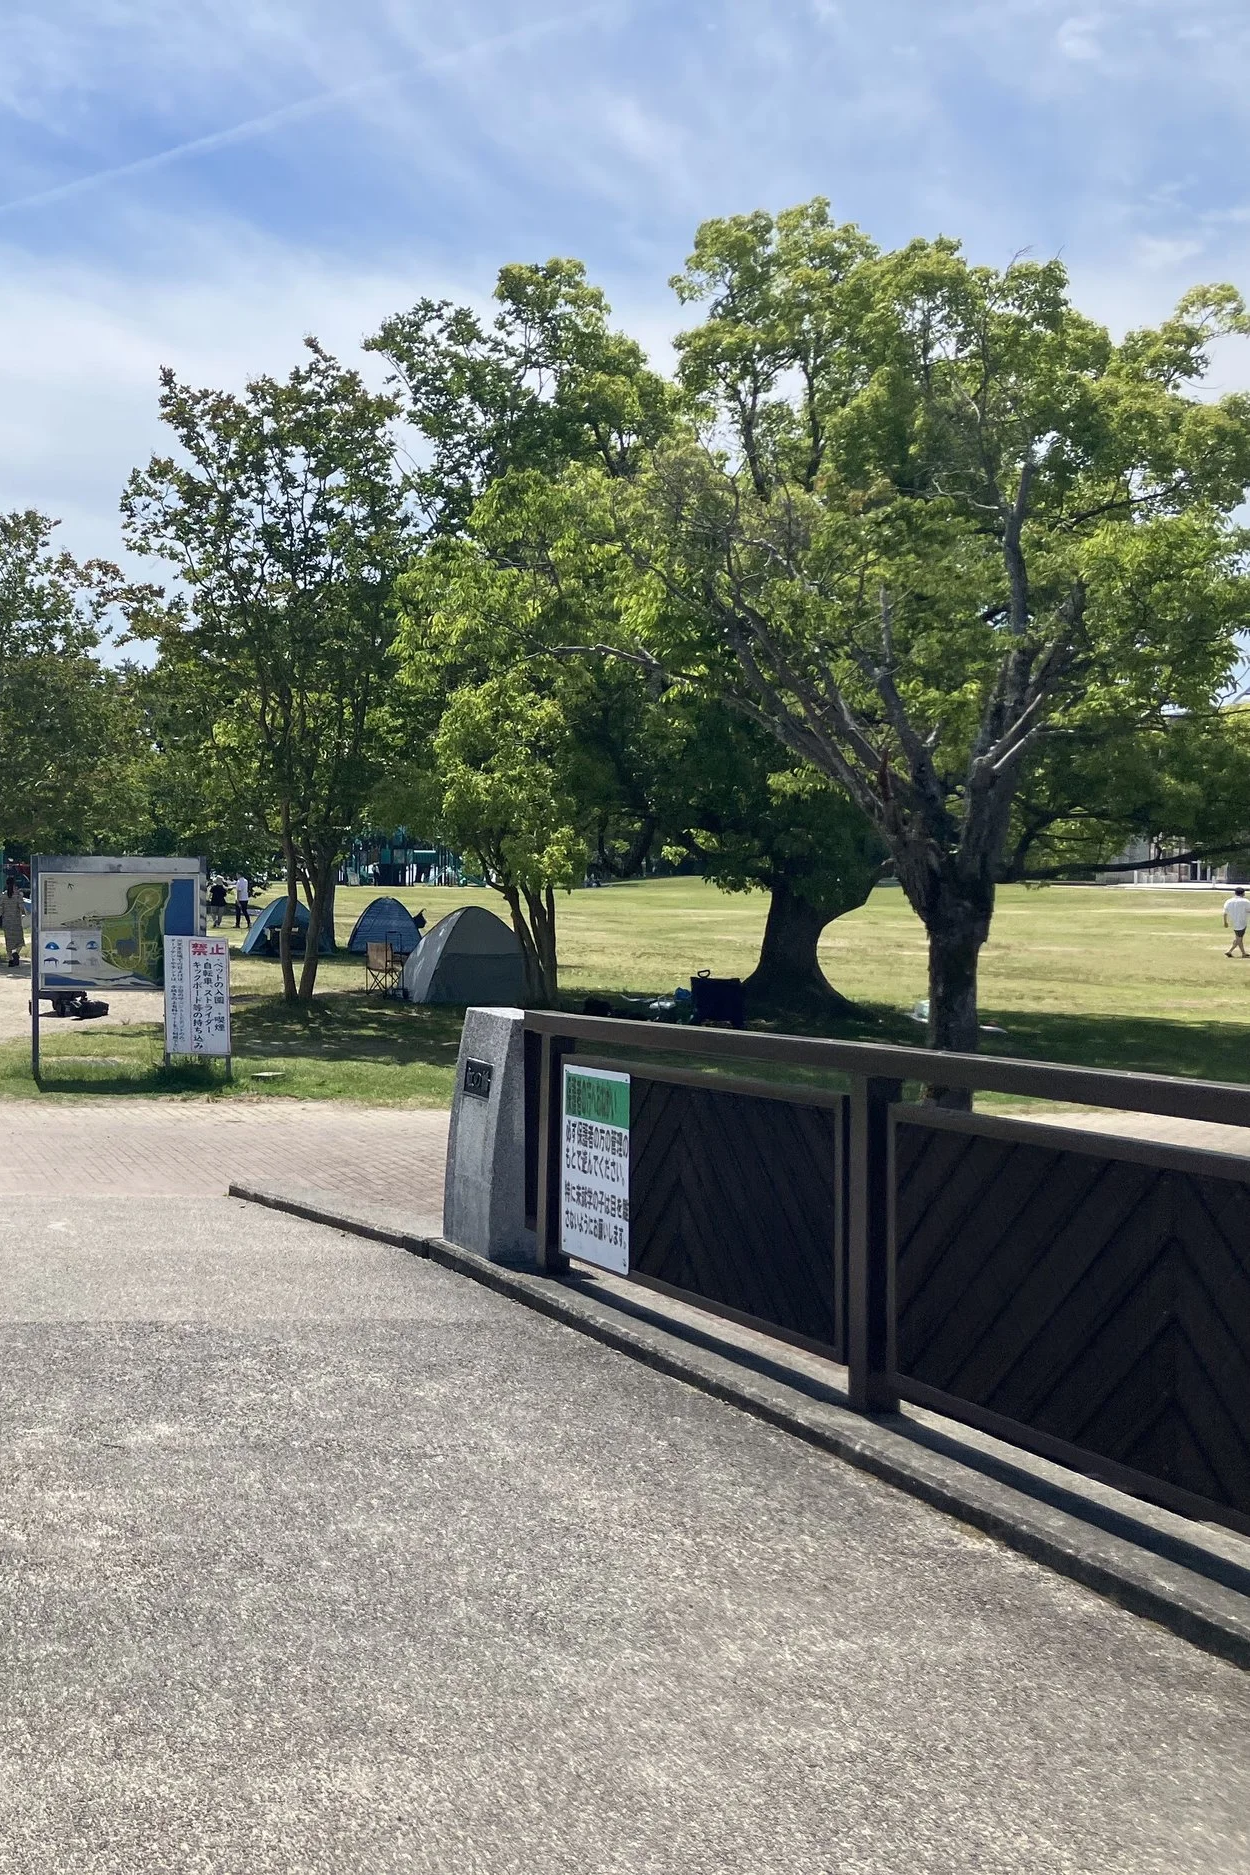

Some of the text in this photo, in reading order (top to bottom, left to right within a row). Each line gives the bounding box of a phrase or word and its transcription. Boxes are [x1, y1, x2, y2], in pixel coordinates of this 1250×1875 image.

[192, 943, 225, 956] 禁止
[192, 961, 204, 1049] キックボード等の持ち込み
[566, 1119, 629, 1158] 必ず保護者の方の管理の
[566, 1145, 625, 1187] もとで遊んでください。
[565, 1180, 629, 1220] 特に未就学の子は目を離
[565, 1208, 626, 1250] さないようにお願いします。
